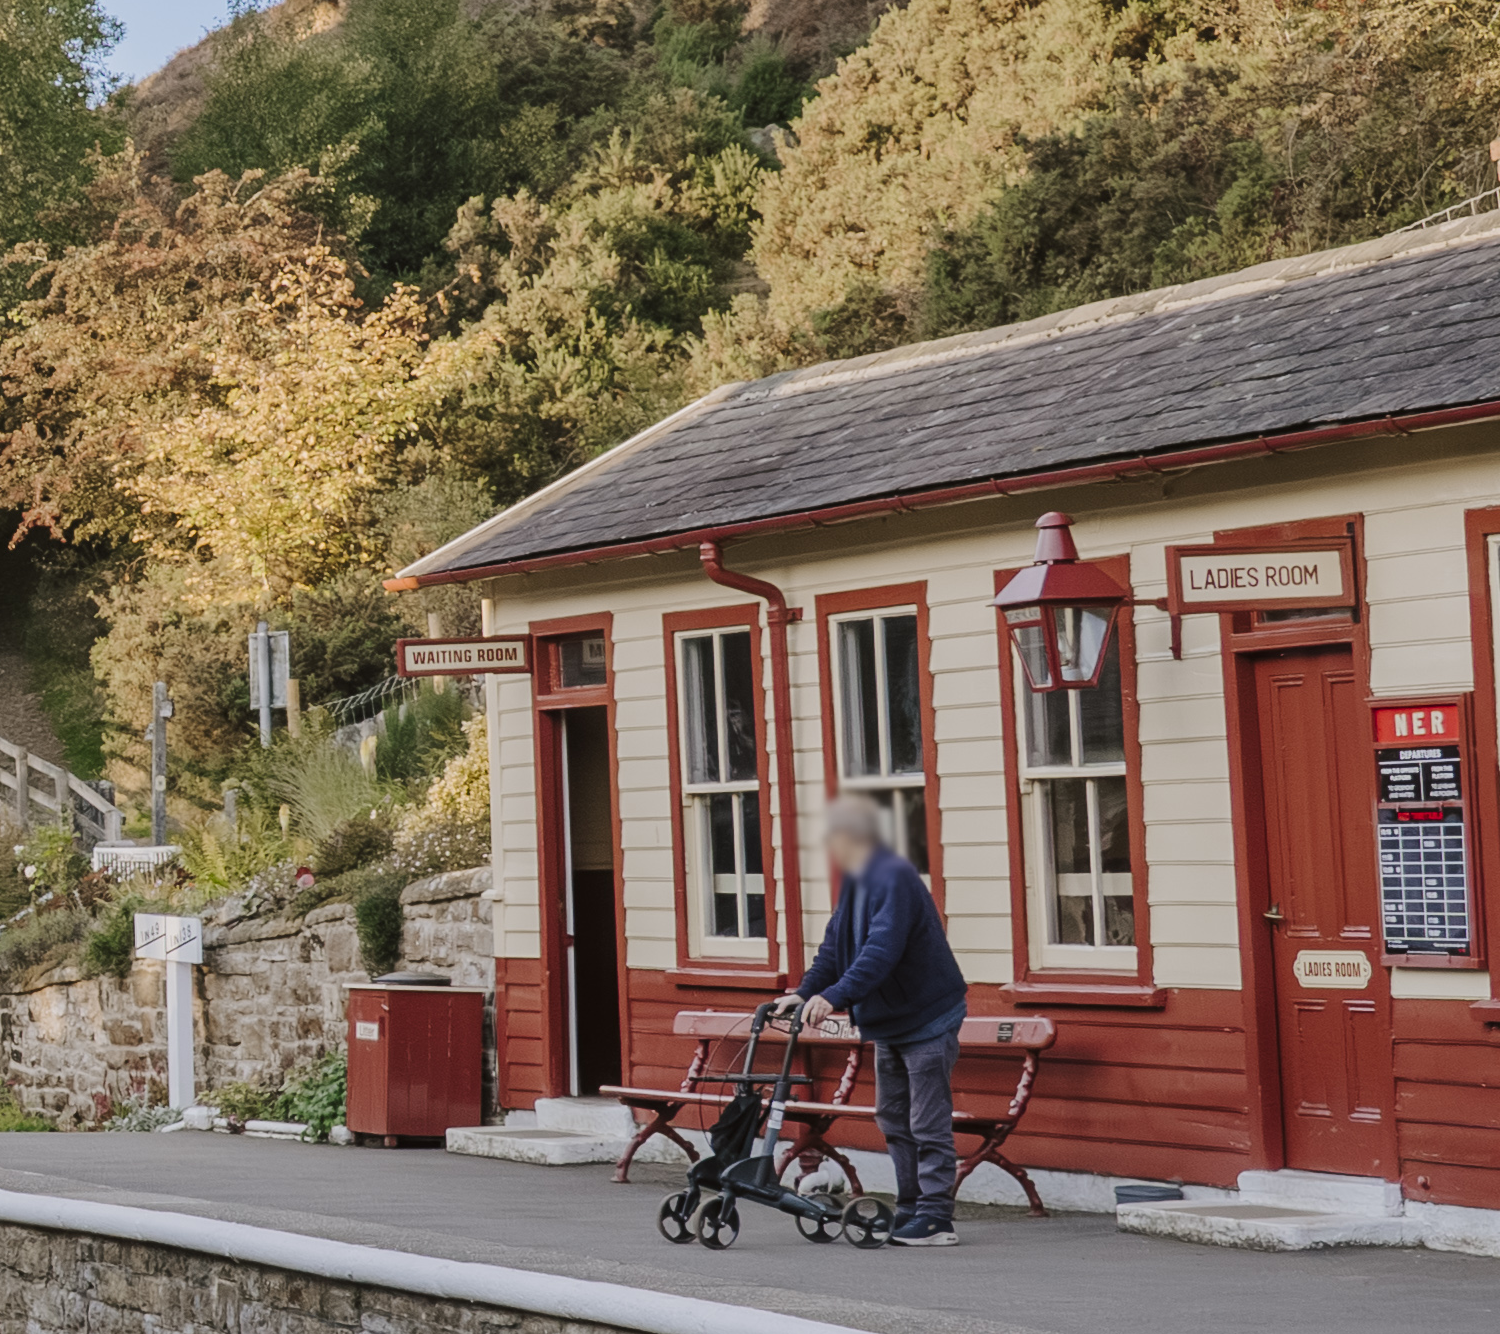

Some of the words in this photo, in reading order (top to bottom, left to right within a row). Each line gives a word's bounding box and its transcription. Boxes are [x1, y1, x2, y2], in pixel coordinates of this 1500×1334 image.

[1190, 567, 1259, 590] LADIES
[1265, 564, 1319, 588] ROOM
[412, 649, 472, 665] WAITING
[477, 647, 518, 662] ROOM
[1394, 710, 1445, 737] NER
[1303, 962, 1332, 977] LADIES
[1335, 962, 1361, 977] ROOM
